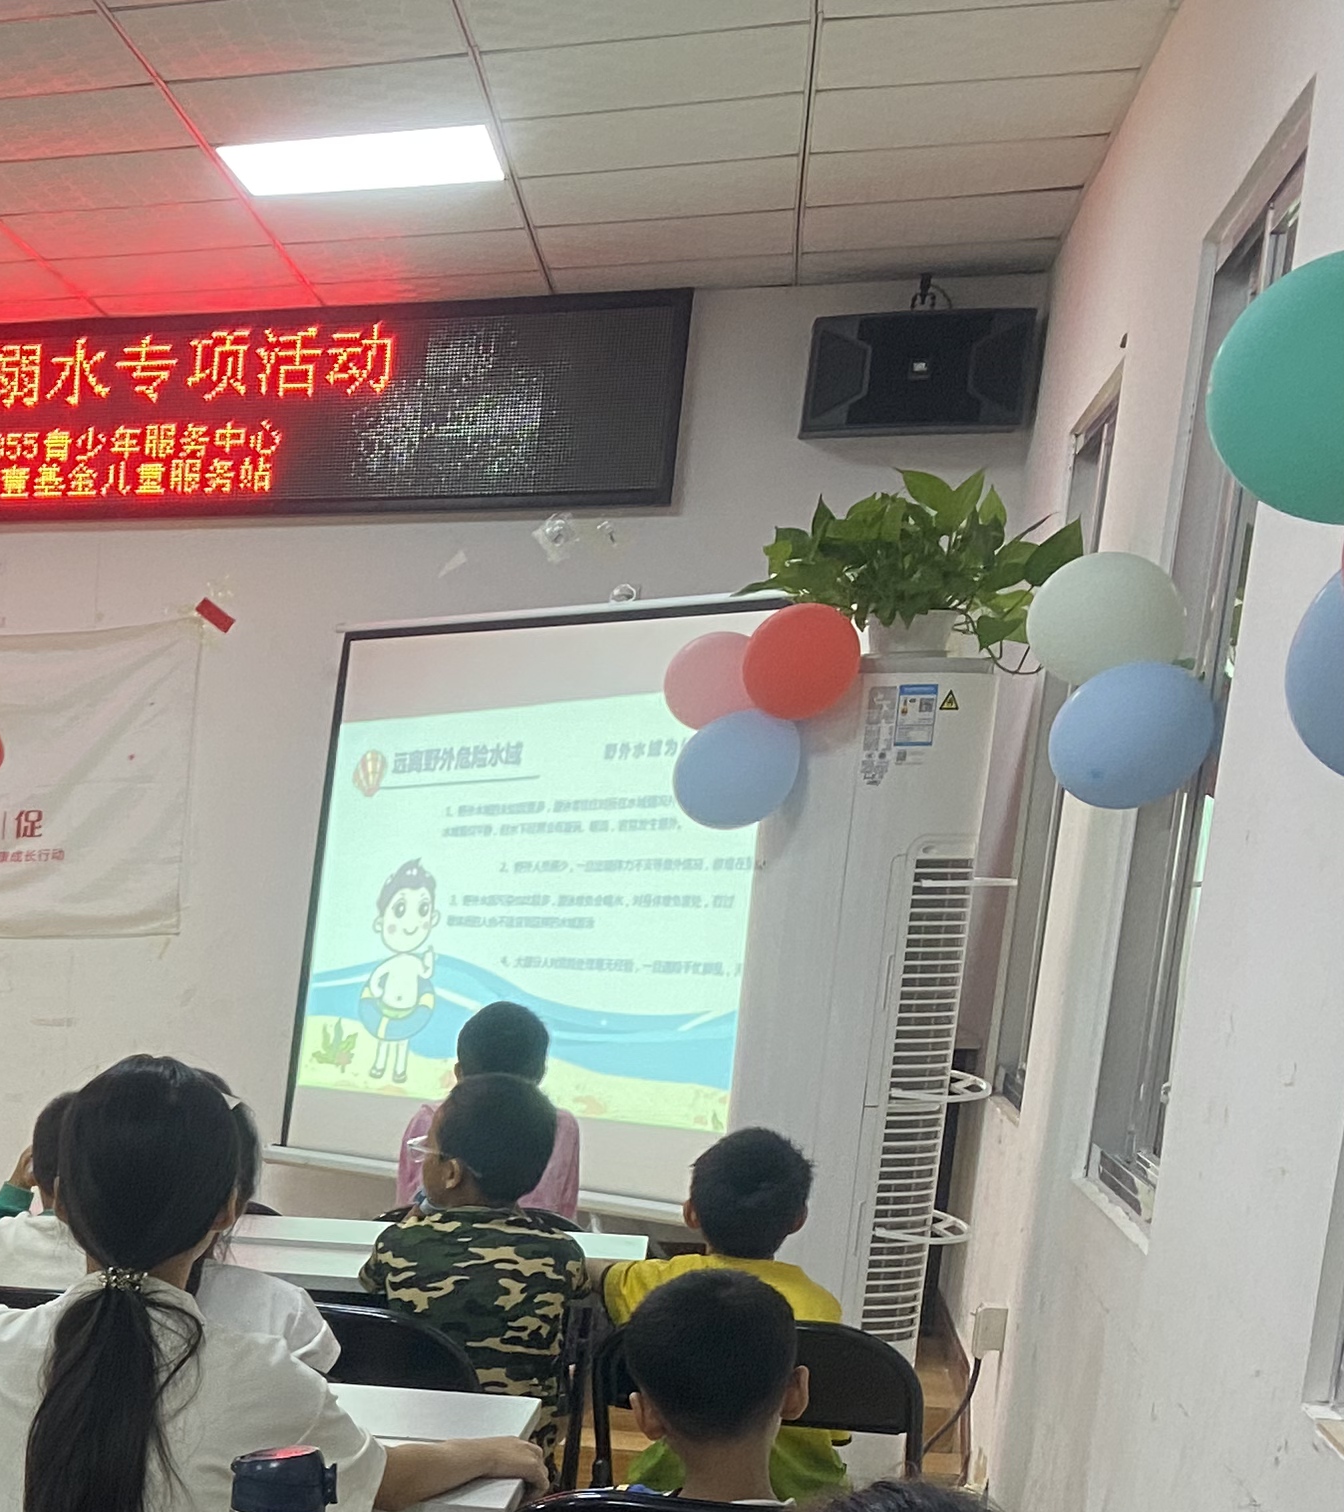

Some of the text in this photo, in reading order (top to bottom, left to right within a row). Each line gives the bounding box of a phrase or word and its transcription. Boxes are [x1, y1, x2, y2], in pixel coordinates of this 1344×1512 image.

[391, 737, 688, 775] 远离野外危险水域 野外水域为
